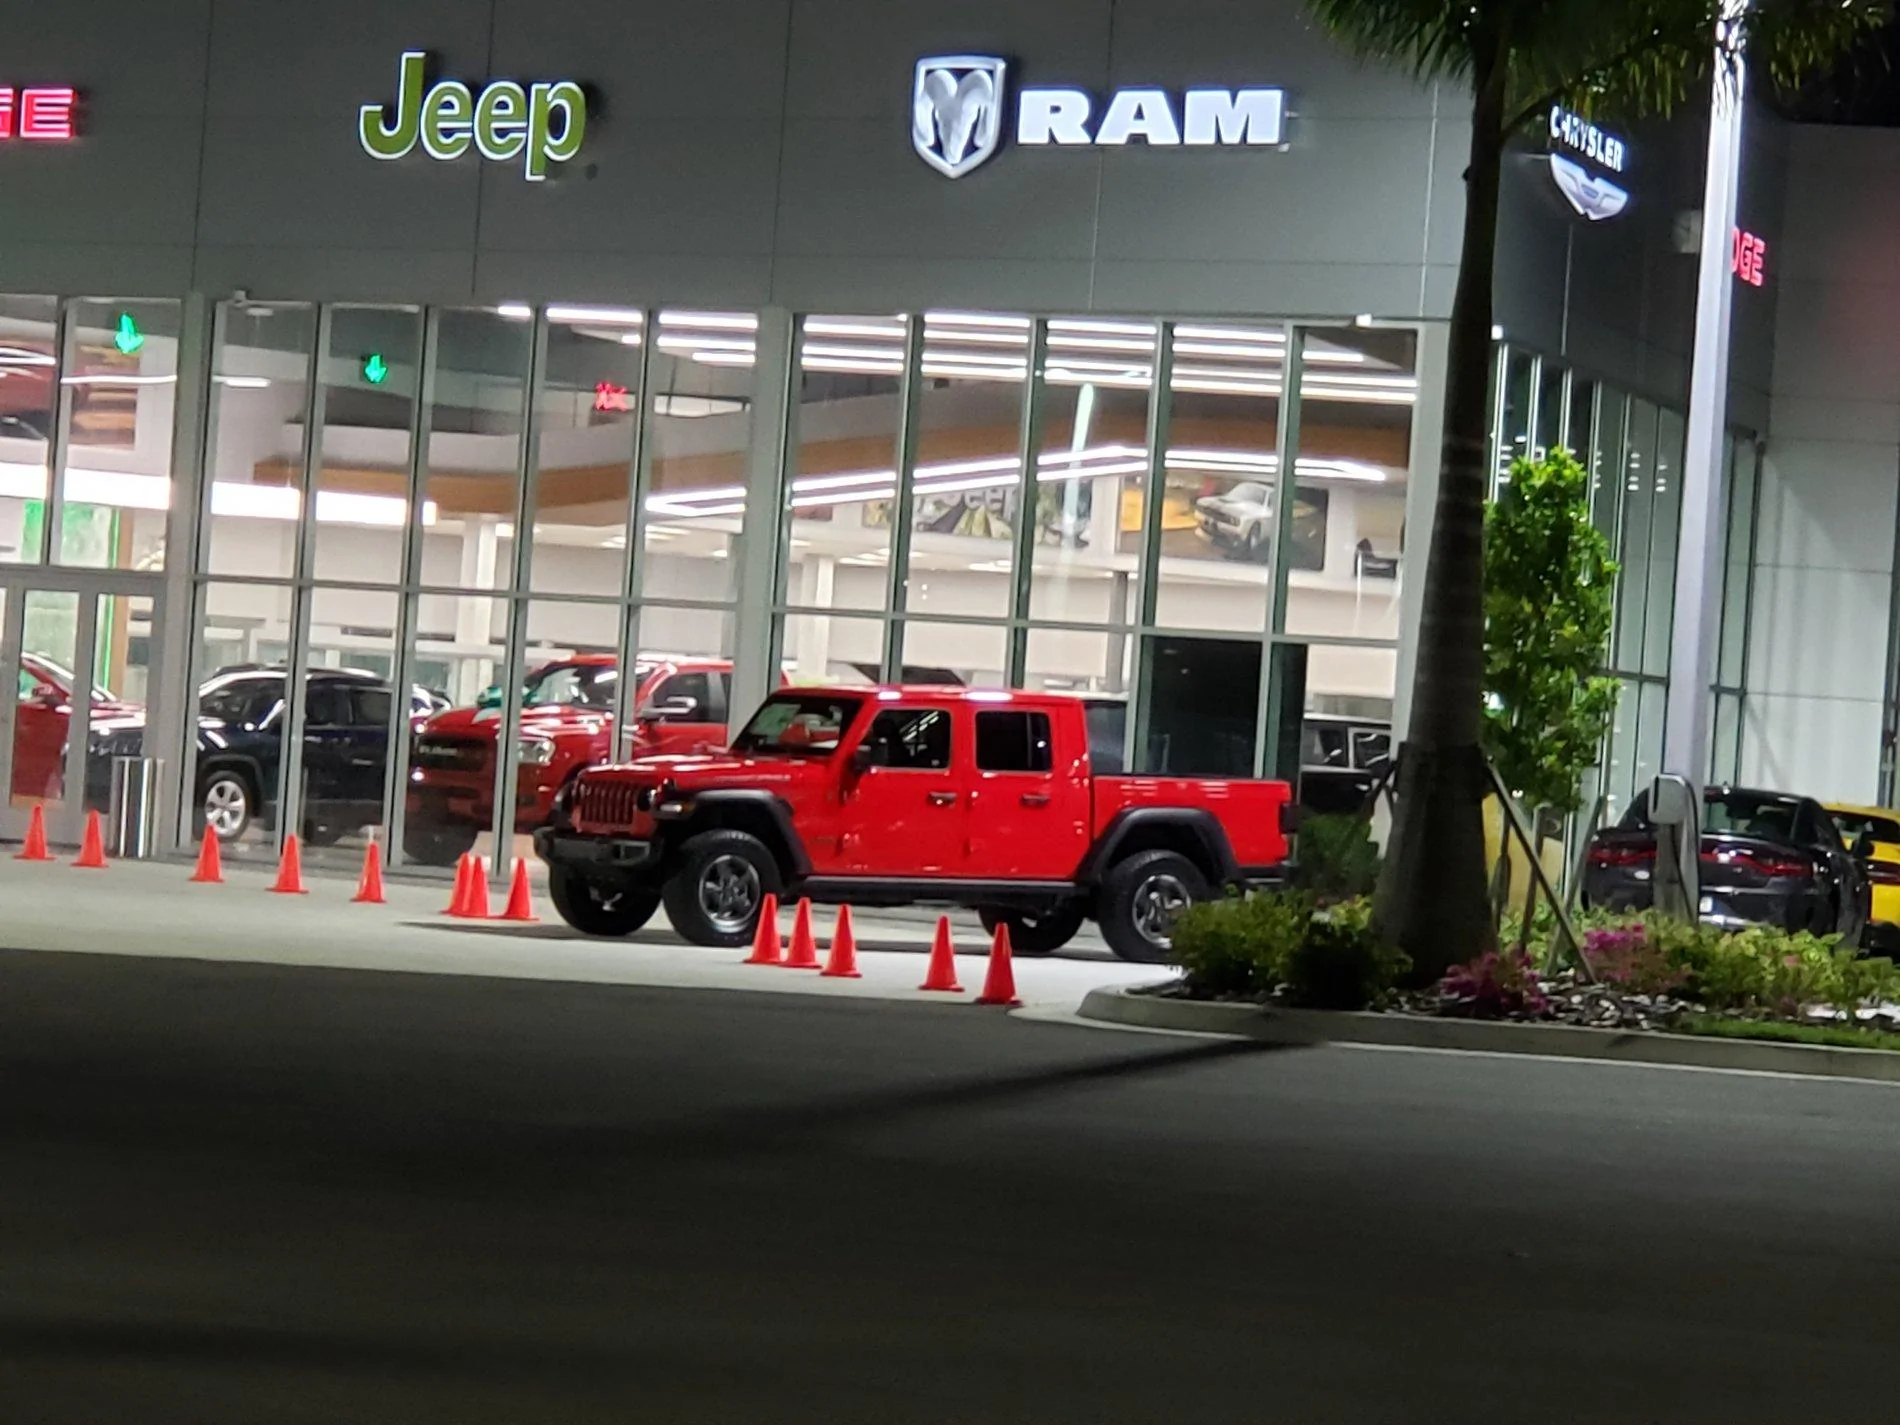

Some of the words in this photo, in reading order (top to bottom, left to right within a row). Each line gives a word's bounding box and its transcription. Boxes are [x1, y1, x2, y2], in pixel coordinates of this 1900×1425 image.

[359, 51, 585, 181] Jeep
[1018, 89, 1283, 144] RAM
[1550, 105, 1623, 172] CHRYSLER
